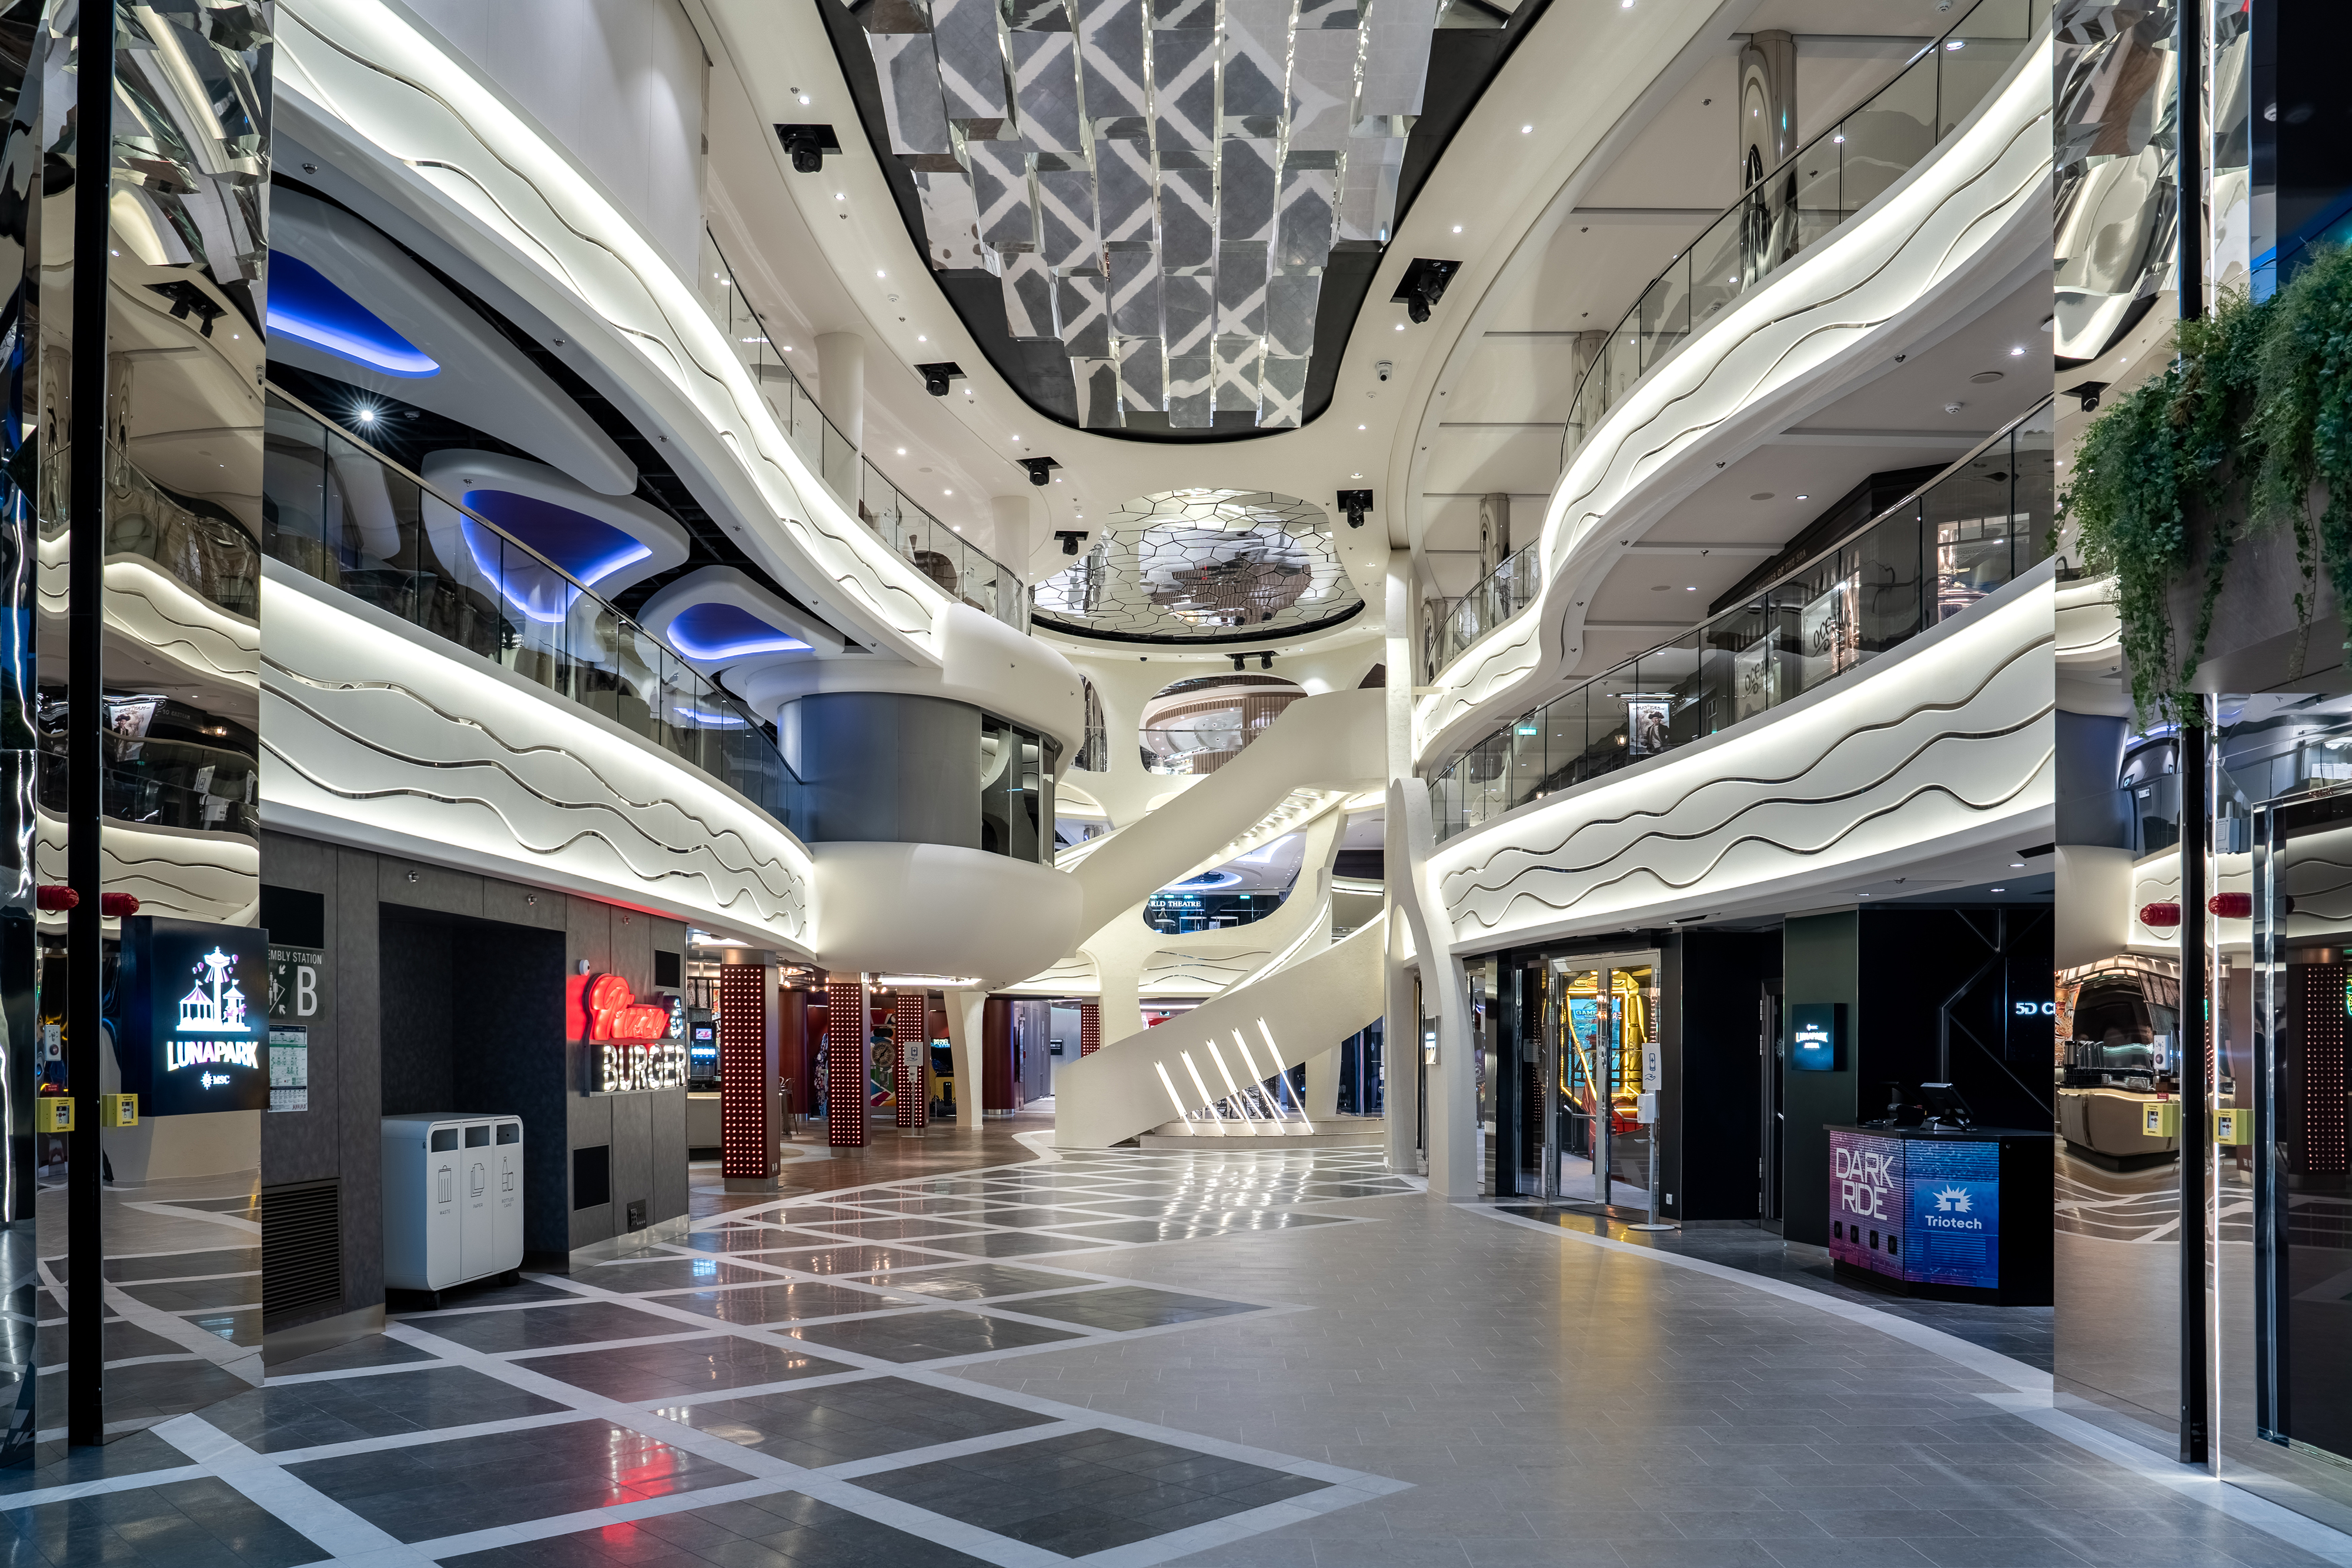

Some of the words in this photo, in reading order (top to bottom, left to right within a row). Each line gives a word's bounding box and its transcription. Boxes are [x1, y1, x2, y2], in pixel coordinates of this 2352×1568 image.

[1756, 571, 1776, 591] MASTERS
[1777, 565, 1785, 577] OF
[1785, 557, 1796, 570] THE
[1796, 549, 1807, 563] SEA
[293, 951, 322, 965] STATION
[298, 965, 318, 1017] B
[2015, 1002, 2038, 1015] 5D
[166, 1041, 259, 1072] LUNAPARK
[603, 1043, 687, 1093] BURGER
[213, 1075, 230, 1085] MSC
[1836, 1147, 1895, 1189] DARK
[1842, 1179, 1887, 1221] RIDE
[1925, 1215, 1982, 1229] Triotech
